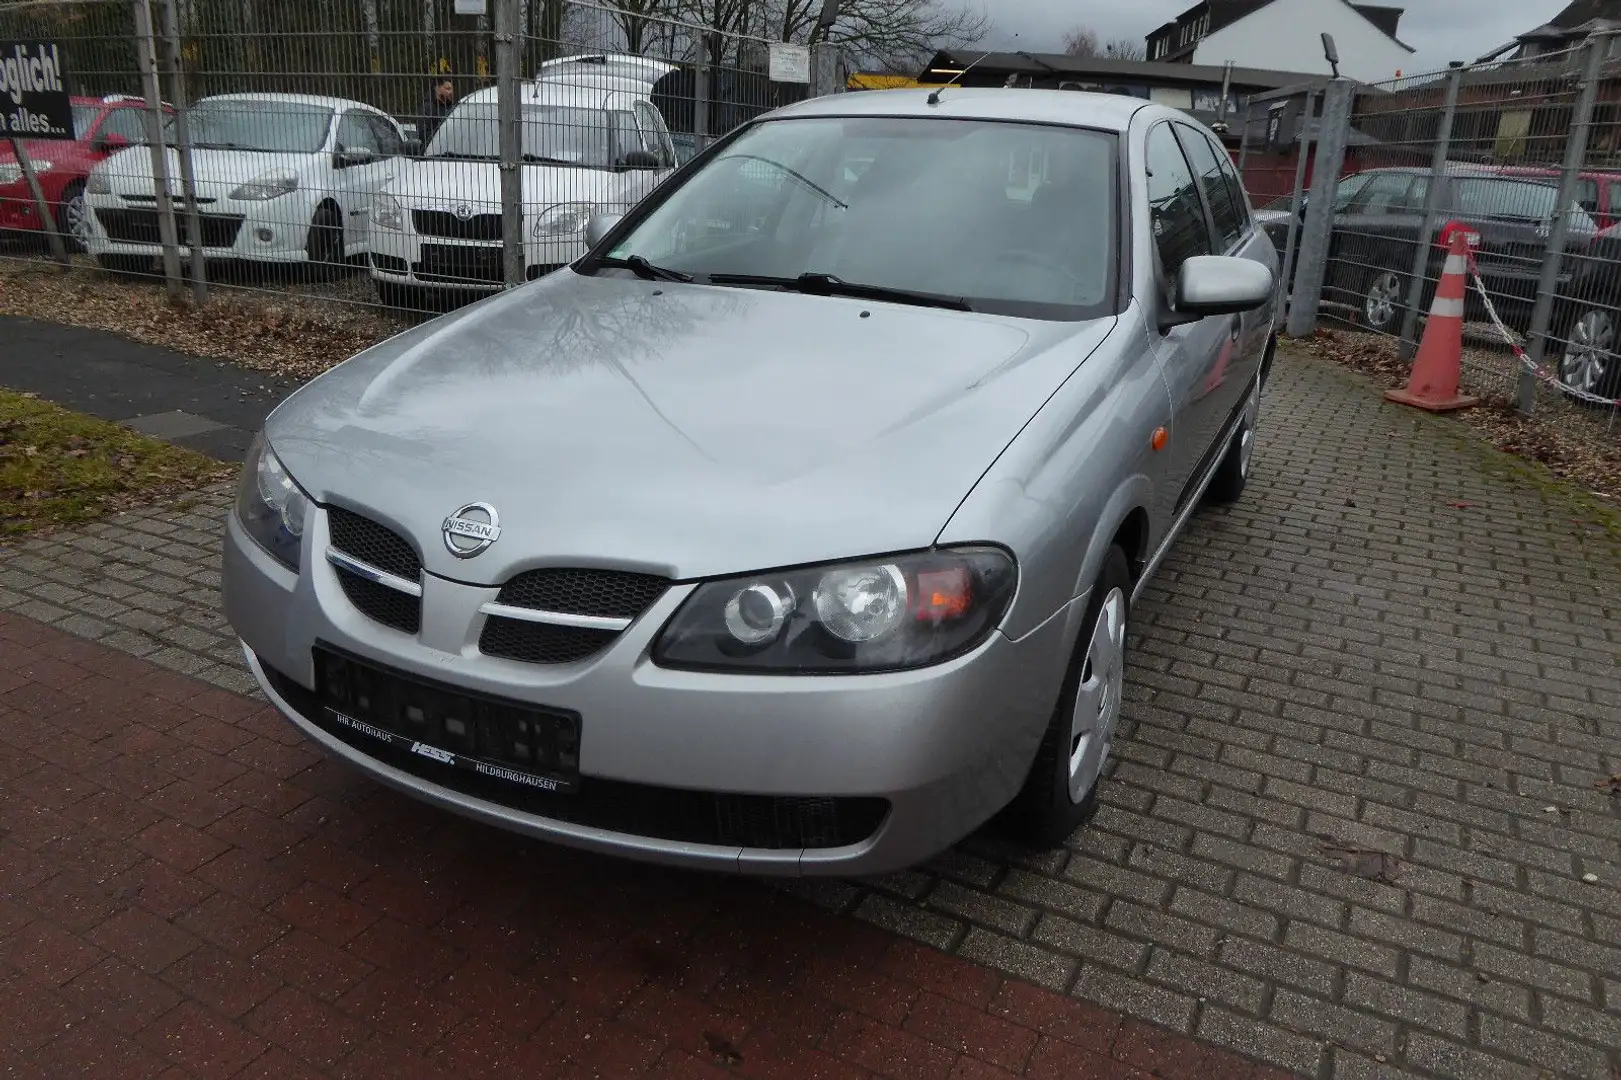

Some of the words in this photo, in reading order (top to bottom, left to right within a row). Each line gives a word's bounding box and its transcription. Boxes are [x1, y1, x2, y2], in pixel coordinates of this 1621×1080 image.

[10, 107, 66, 133] alles...
[445, 519, 492, 537] NISSAN
[337, 714, 349, 726] IHR
[351, 720, 392, 743] AUTOHAUS
[476, 763, 557, 790] HILDBURGHAUSEN
